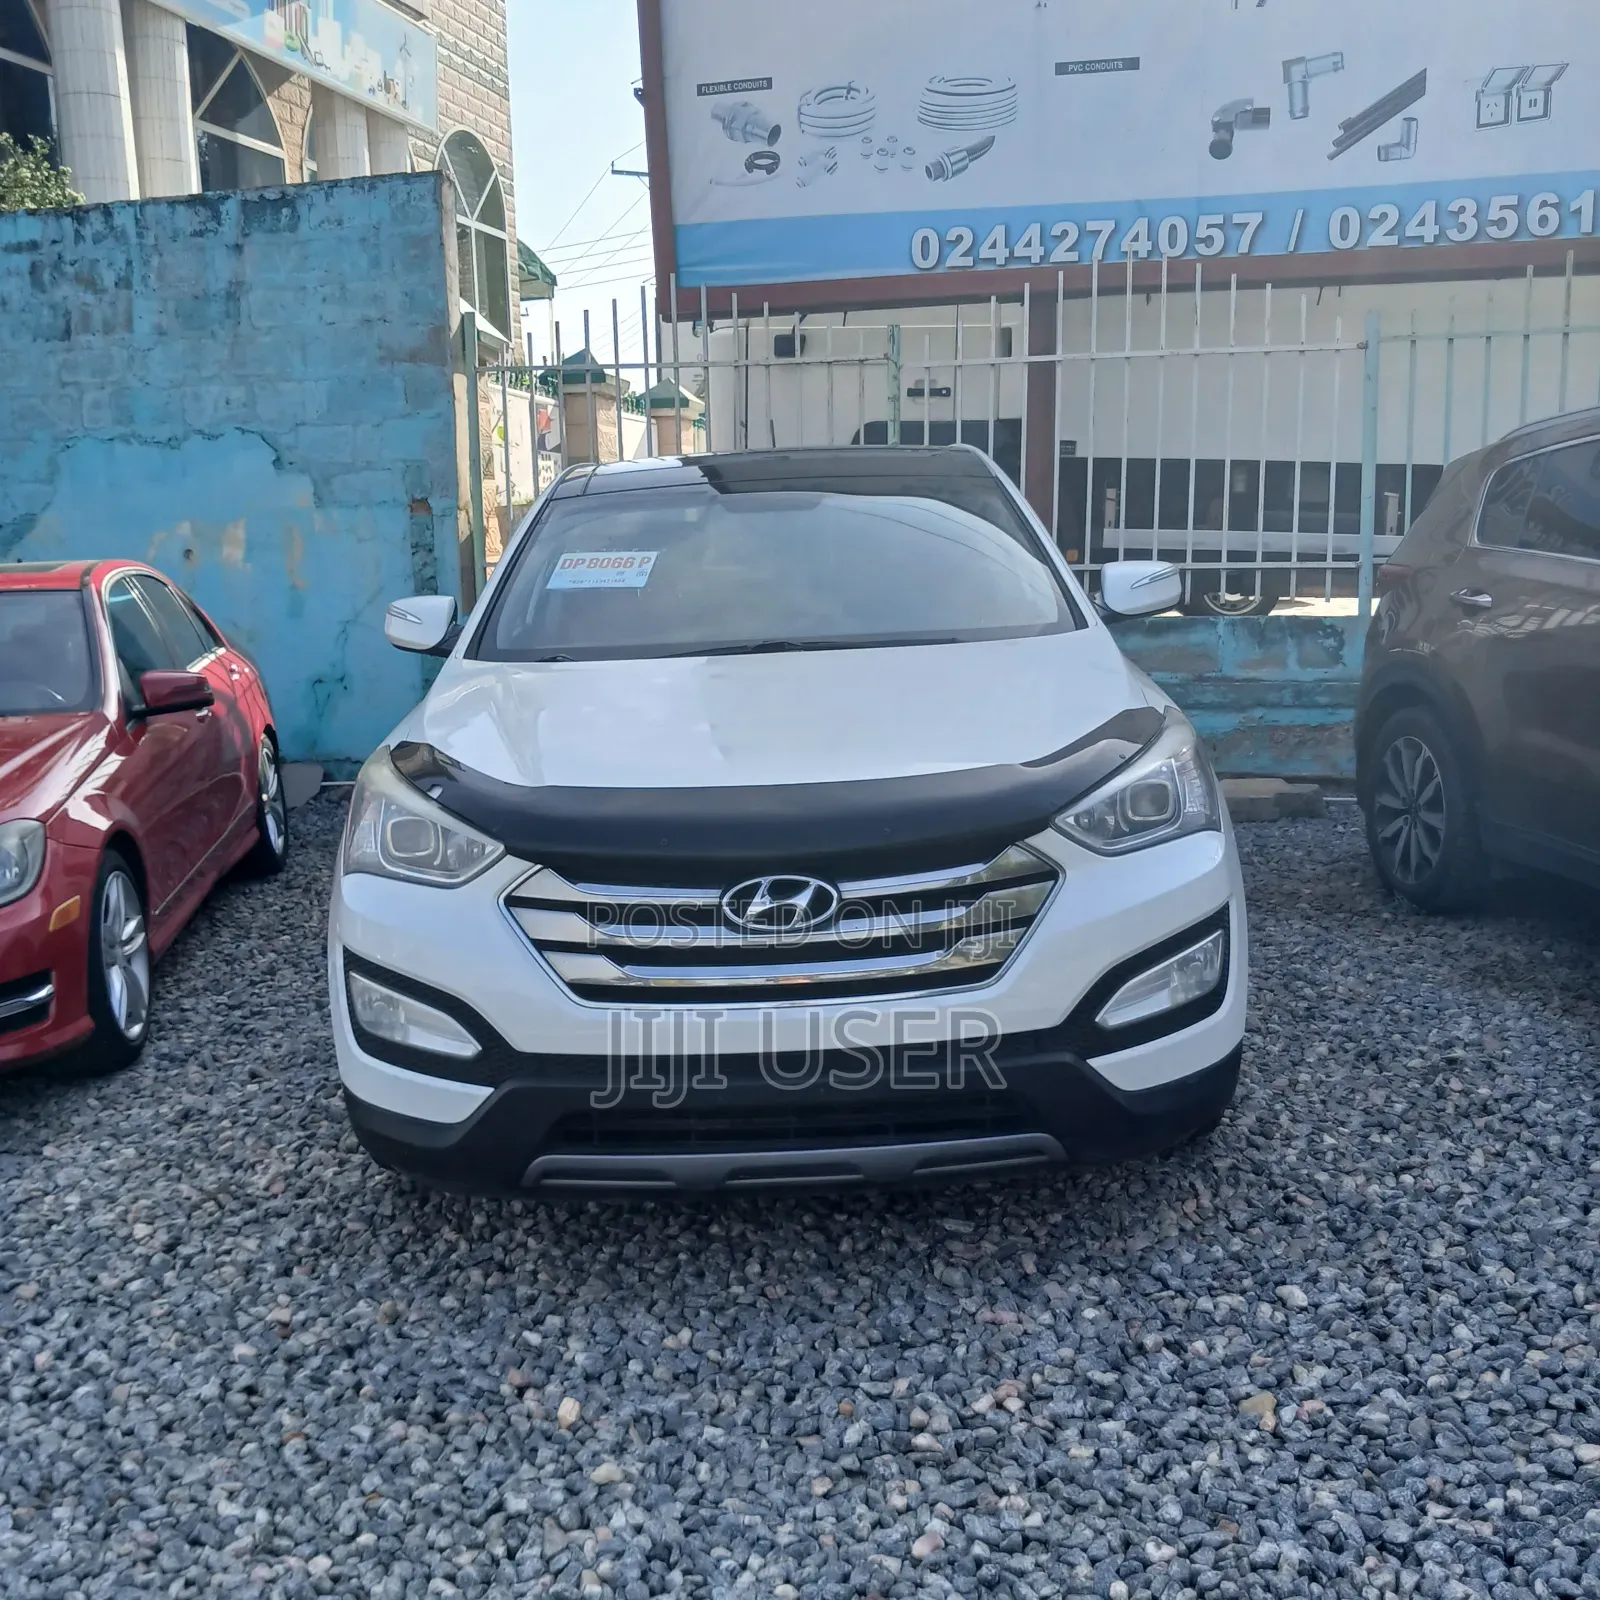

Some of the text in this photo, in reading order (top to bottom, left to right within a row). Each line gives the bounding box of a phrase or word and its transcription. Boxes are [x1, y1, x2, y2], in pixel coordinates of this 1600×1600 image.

[1068, 61, 1123, 72] PVC CONDUITS
[701, 80, 768, 94] FLEXIBLE CONDUITS
[911, 189, 1596, 269] 0244274057 / 0243561
[560, 557, 652, 569] DP 8066 P
